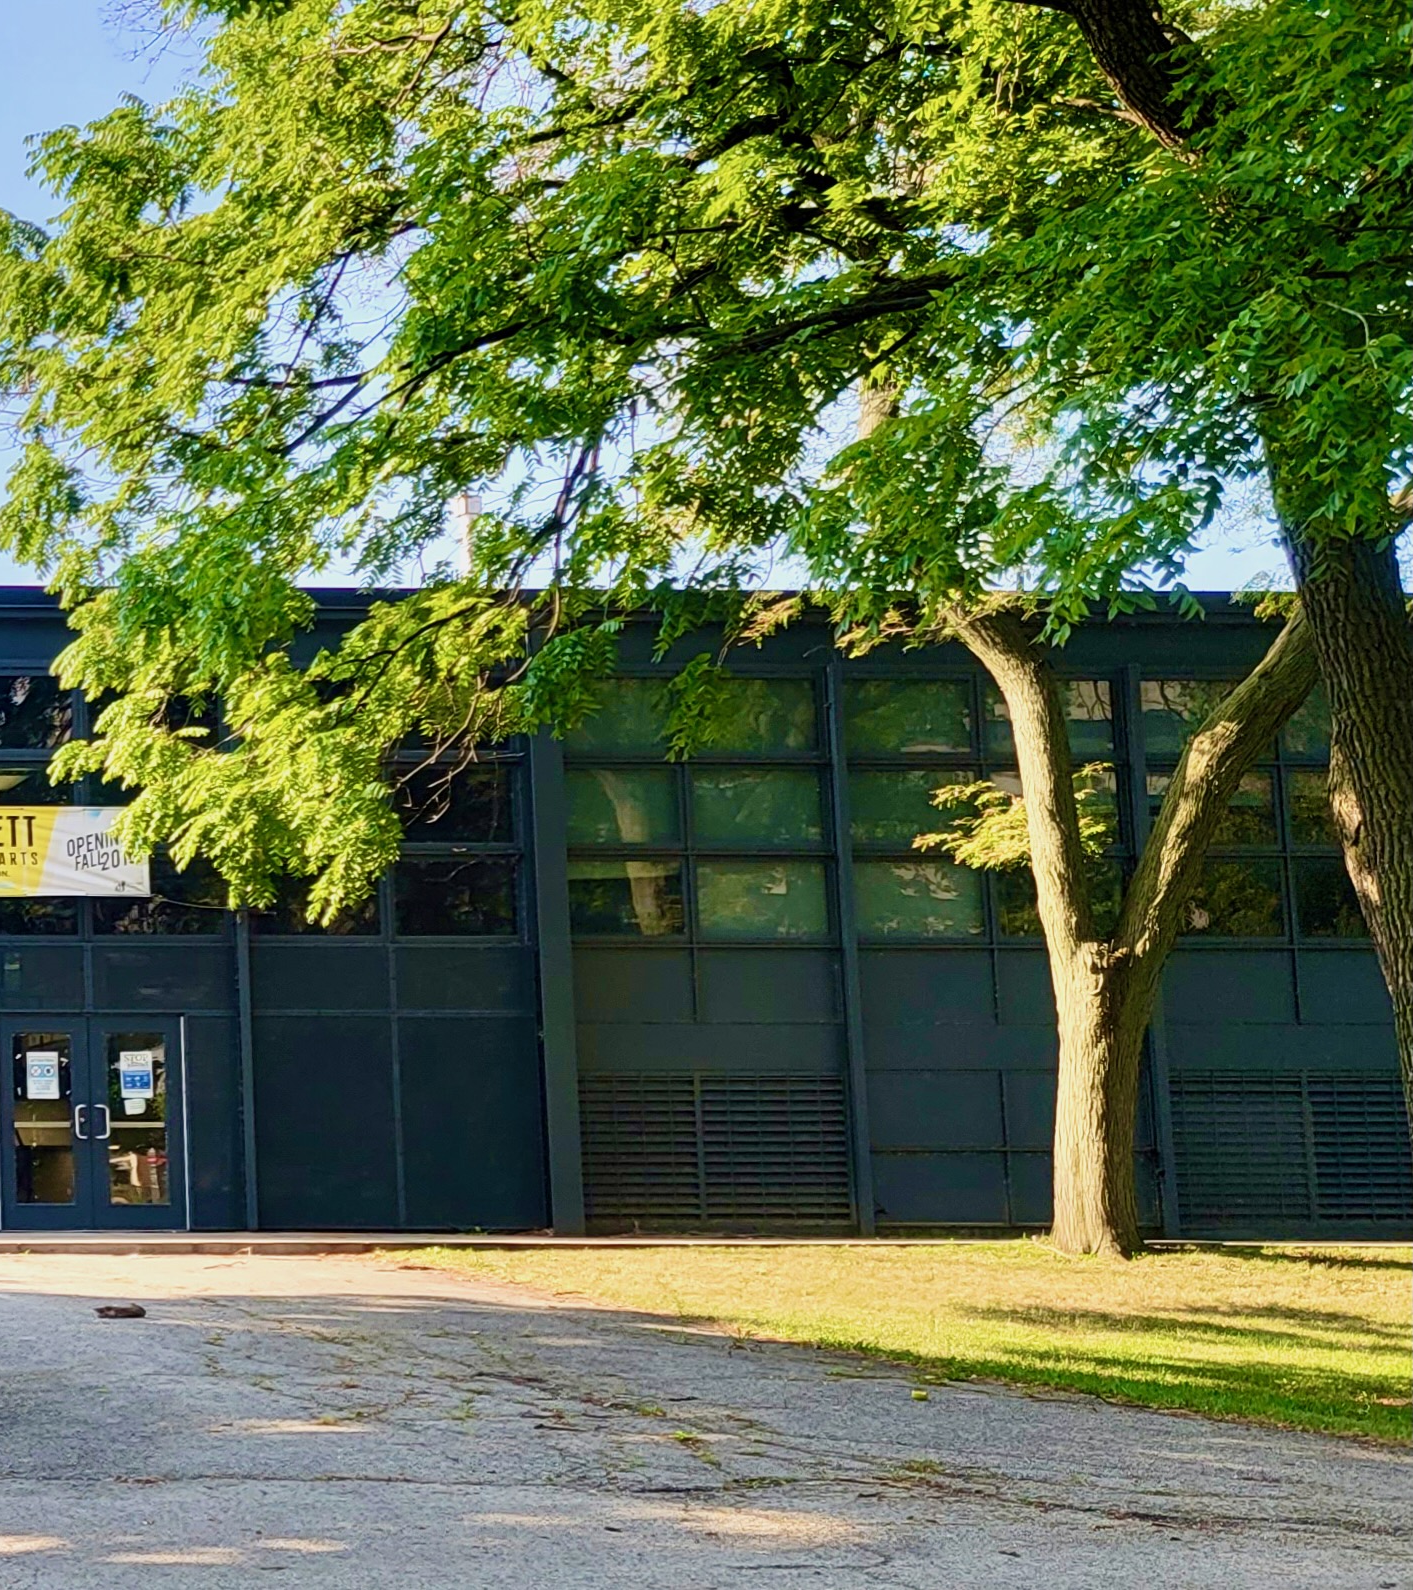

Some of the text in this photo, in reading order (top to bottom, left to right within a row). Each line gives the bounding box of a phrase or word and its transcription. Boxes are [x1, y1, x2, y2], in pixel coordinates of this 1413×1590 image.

[66, 831, 120, 857] OPENIN
[74, 849, 135, 871] FALL 201
